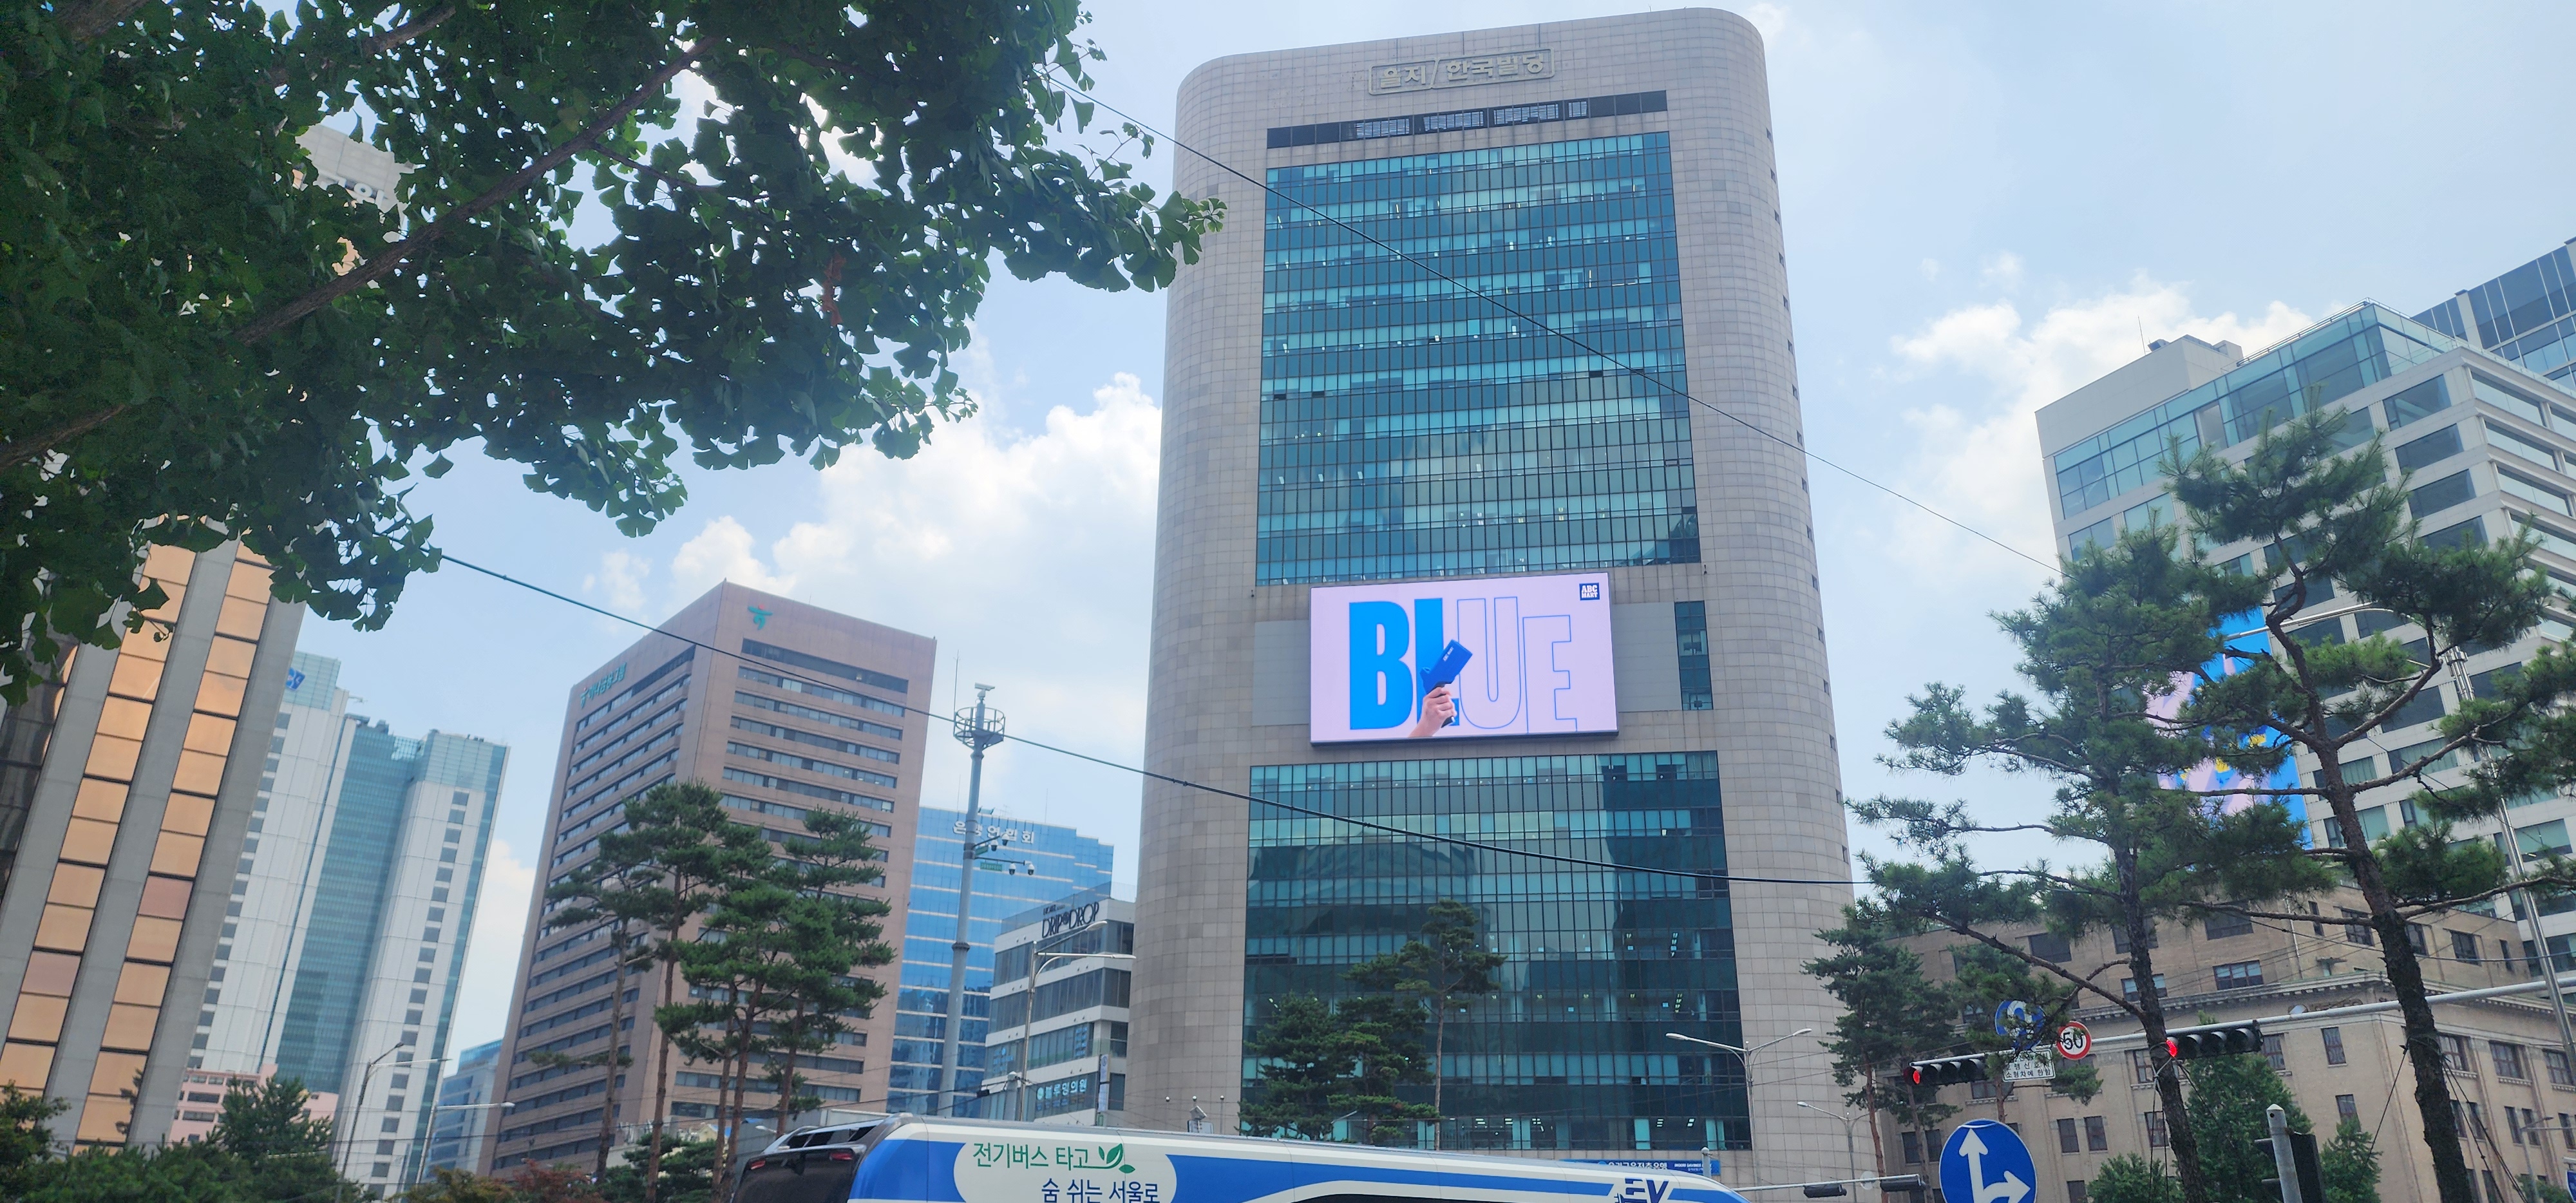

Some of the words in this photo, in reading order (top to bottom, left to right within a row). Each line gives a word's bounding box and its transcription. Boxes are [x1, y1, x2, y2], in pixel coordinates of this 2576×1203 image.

[1380, 65, 1426, 89] 을지
[1446, 53, 1544, 81] 한국빌딩
[1349, 596, 1578, 734] BLUE
[2063, 1032, 2083, 1050] 50
[973, 1142, 1049, 1170] 전기버스
[1056, 1146, 1090, 1171] 타고
[1041, 1178, 1060, 1203] 숨
[1066, 1179, 1103, 1203] 쉬는
[1108, 1181, 1160, 1203] 서울로
[1624, 1177, 1670, 1203] EV
